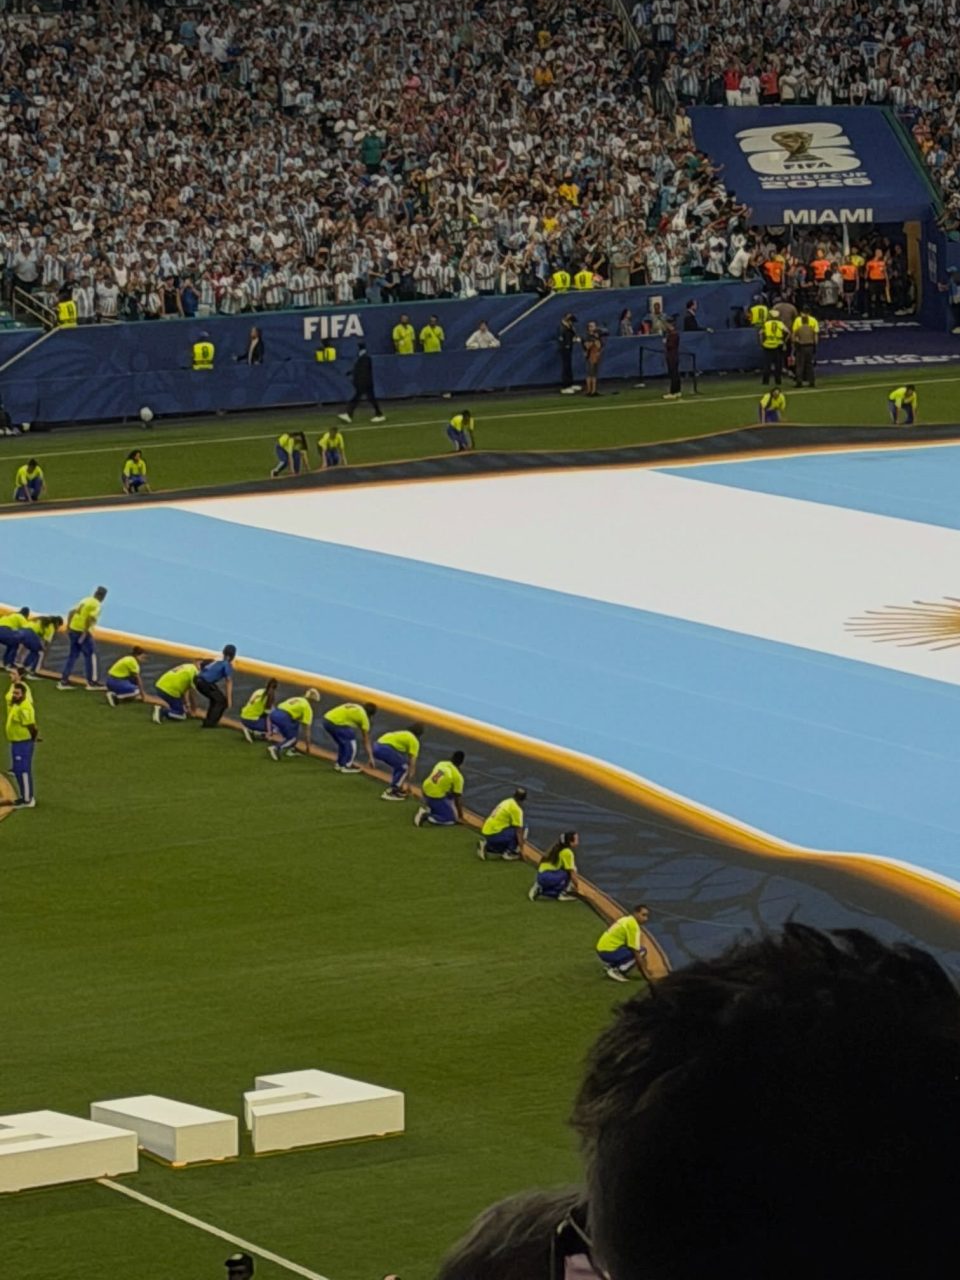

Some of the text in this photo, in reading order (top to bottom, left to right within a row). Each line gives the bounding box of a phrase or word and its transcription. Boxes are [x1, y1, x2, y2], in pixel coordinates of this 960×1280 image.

[782, 162, 832, 170] FIFA
[783, 207, 874, 224] MIAMI
[303, 314, 364, 340] FIFA
